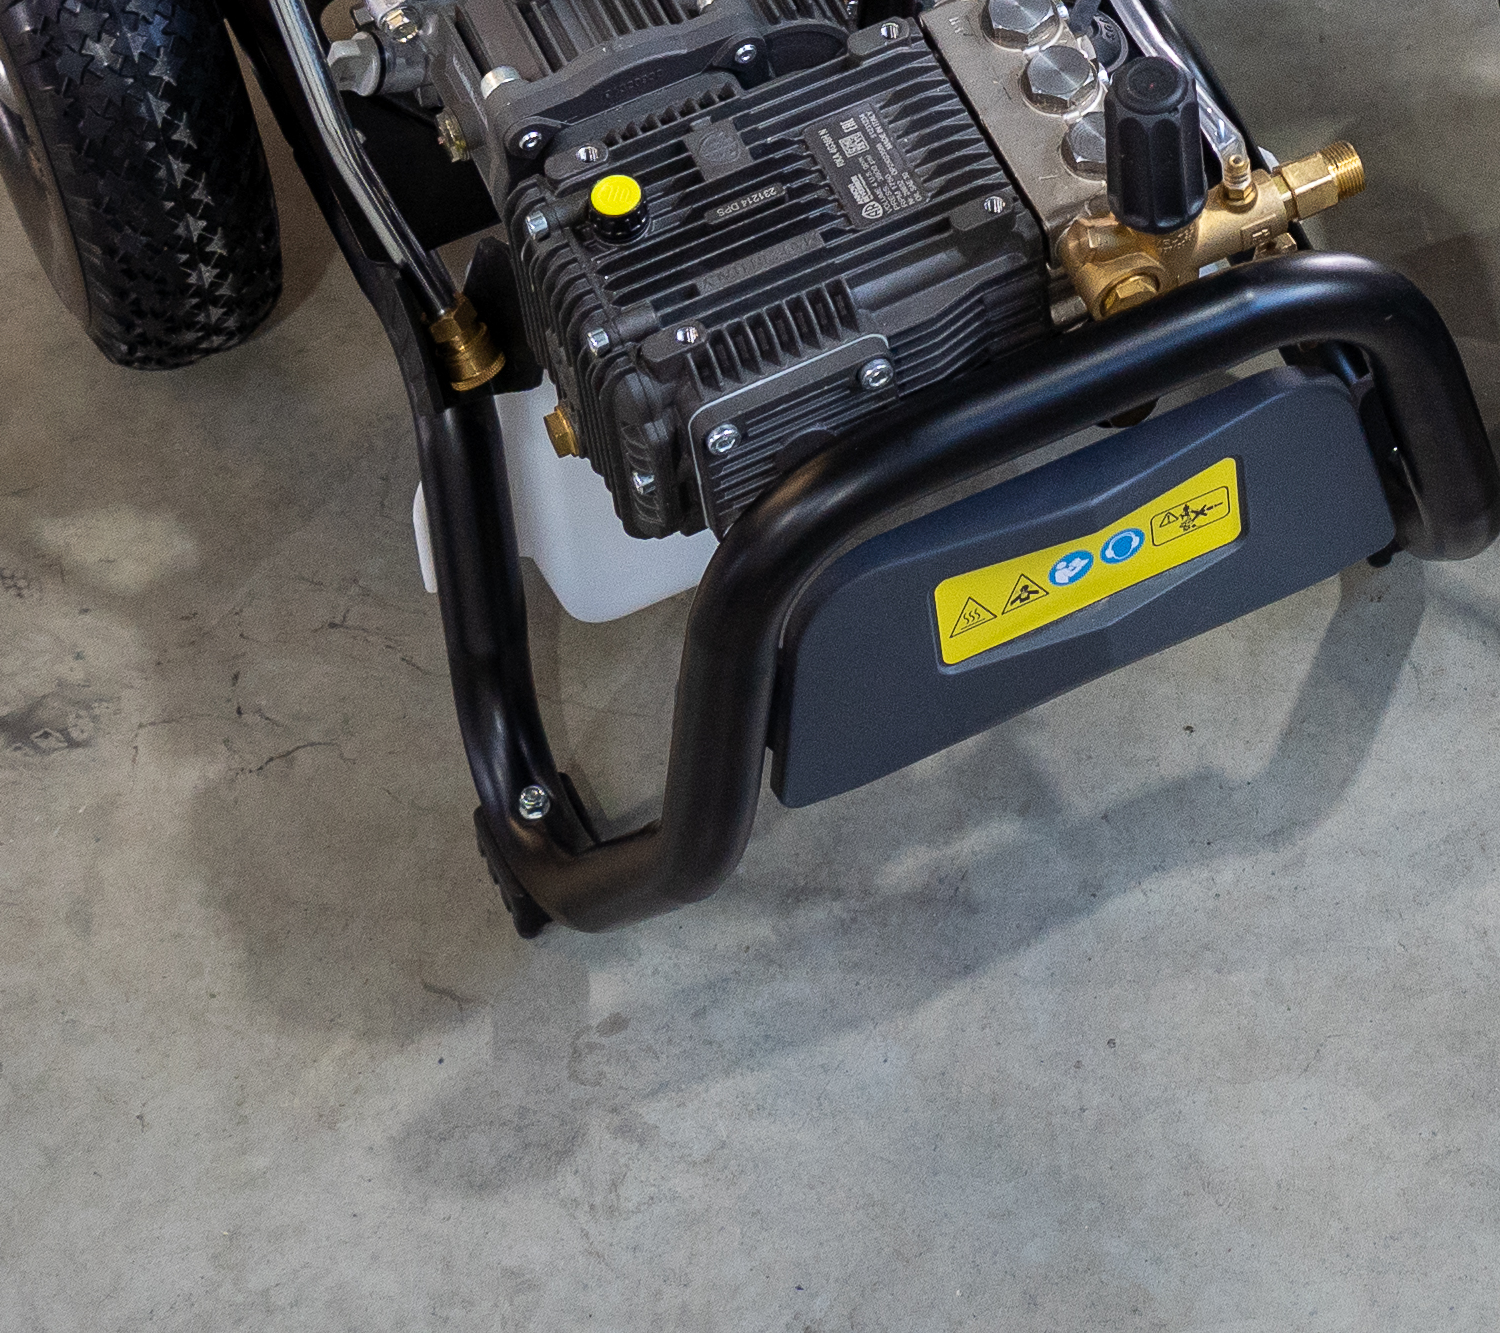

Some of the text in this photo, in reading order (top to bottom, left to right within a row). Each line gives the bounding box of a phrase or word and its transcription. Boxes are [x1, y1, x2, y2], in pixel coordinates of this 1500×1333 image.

[716, 187, 776, 216] 231214 DPS
[874, 187, 892, 213] VOLUME
